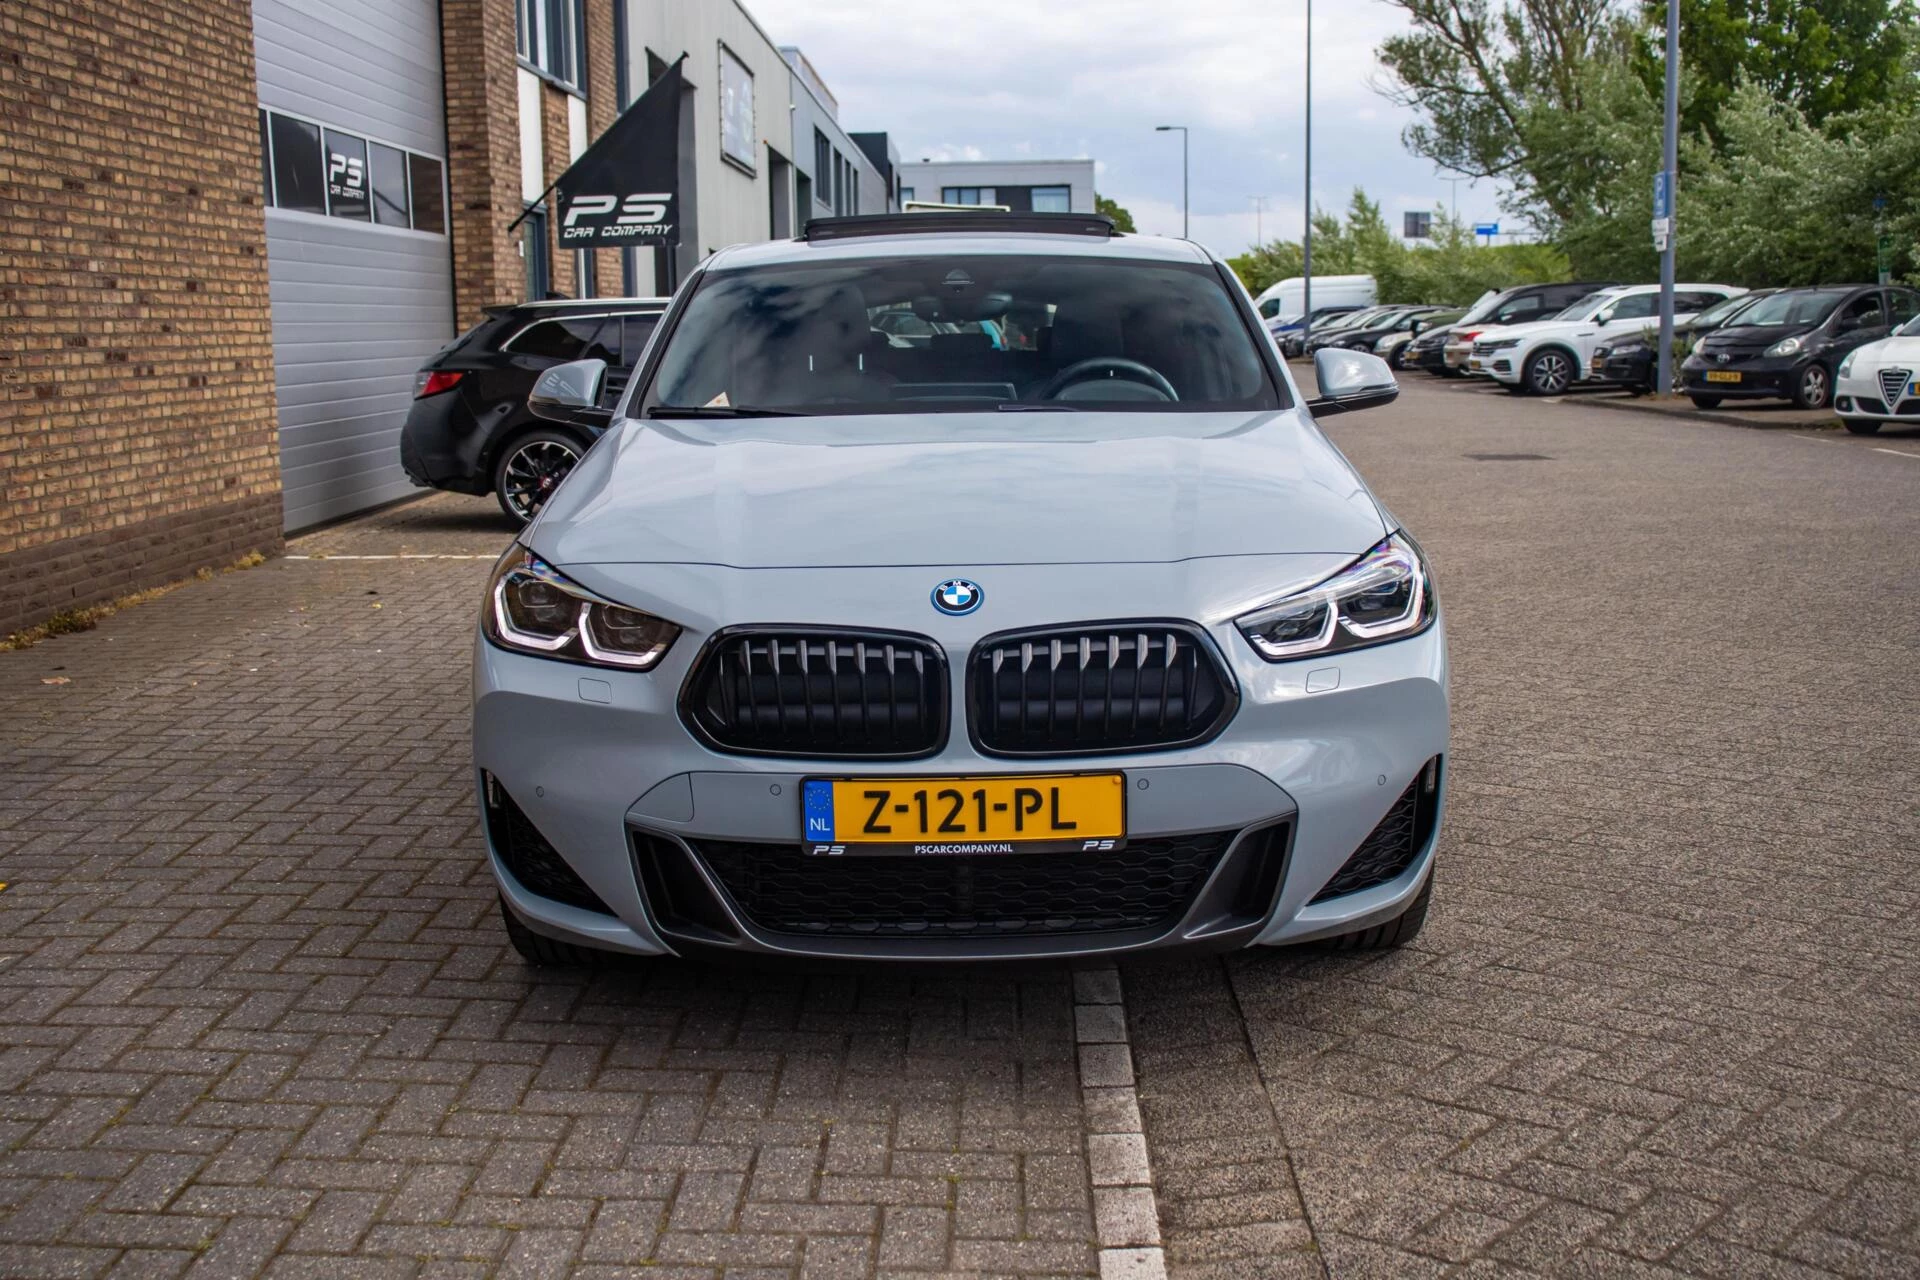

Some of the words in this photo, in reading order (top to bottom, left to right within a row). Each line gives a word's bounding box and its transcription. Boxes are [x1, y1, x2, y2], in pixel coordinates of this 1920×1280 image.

[330, 153, 363, 187] PS
[563, 193, 672, 226] PS
[563, 227, 595, 238] CAR
[601, 224, 672, 237] COMPANY
[940, 580, 976, 591] BMW
[863, 787, 1077, 833] Z-121-PL
[810, 818, 830, 831] NL
[813, 845, 845, 855] PS
[914, 844, 1013, 855] PSCARCOMPANY.NL
[1082, 840, 1115, 851] PS
